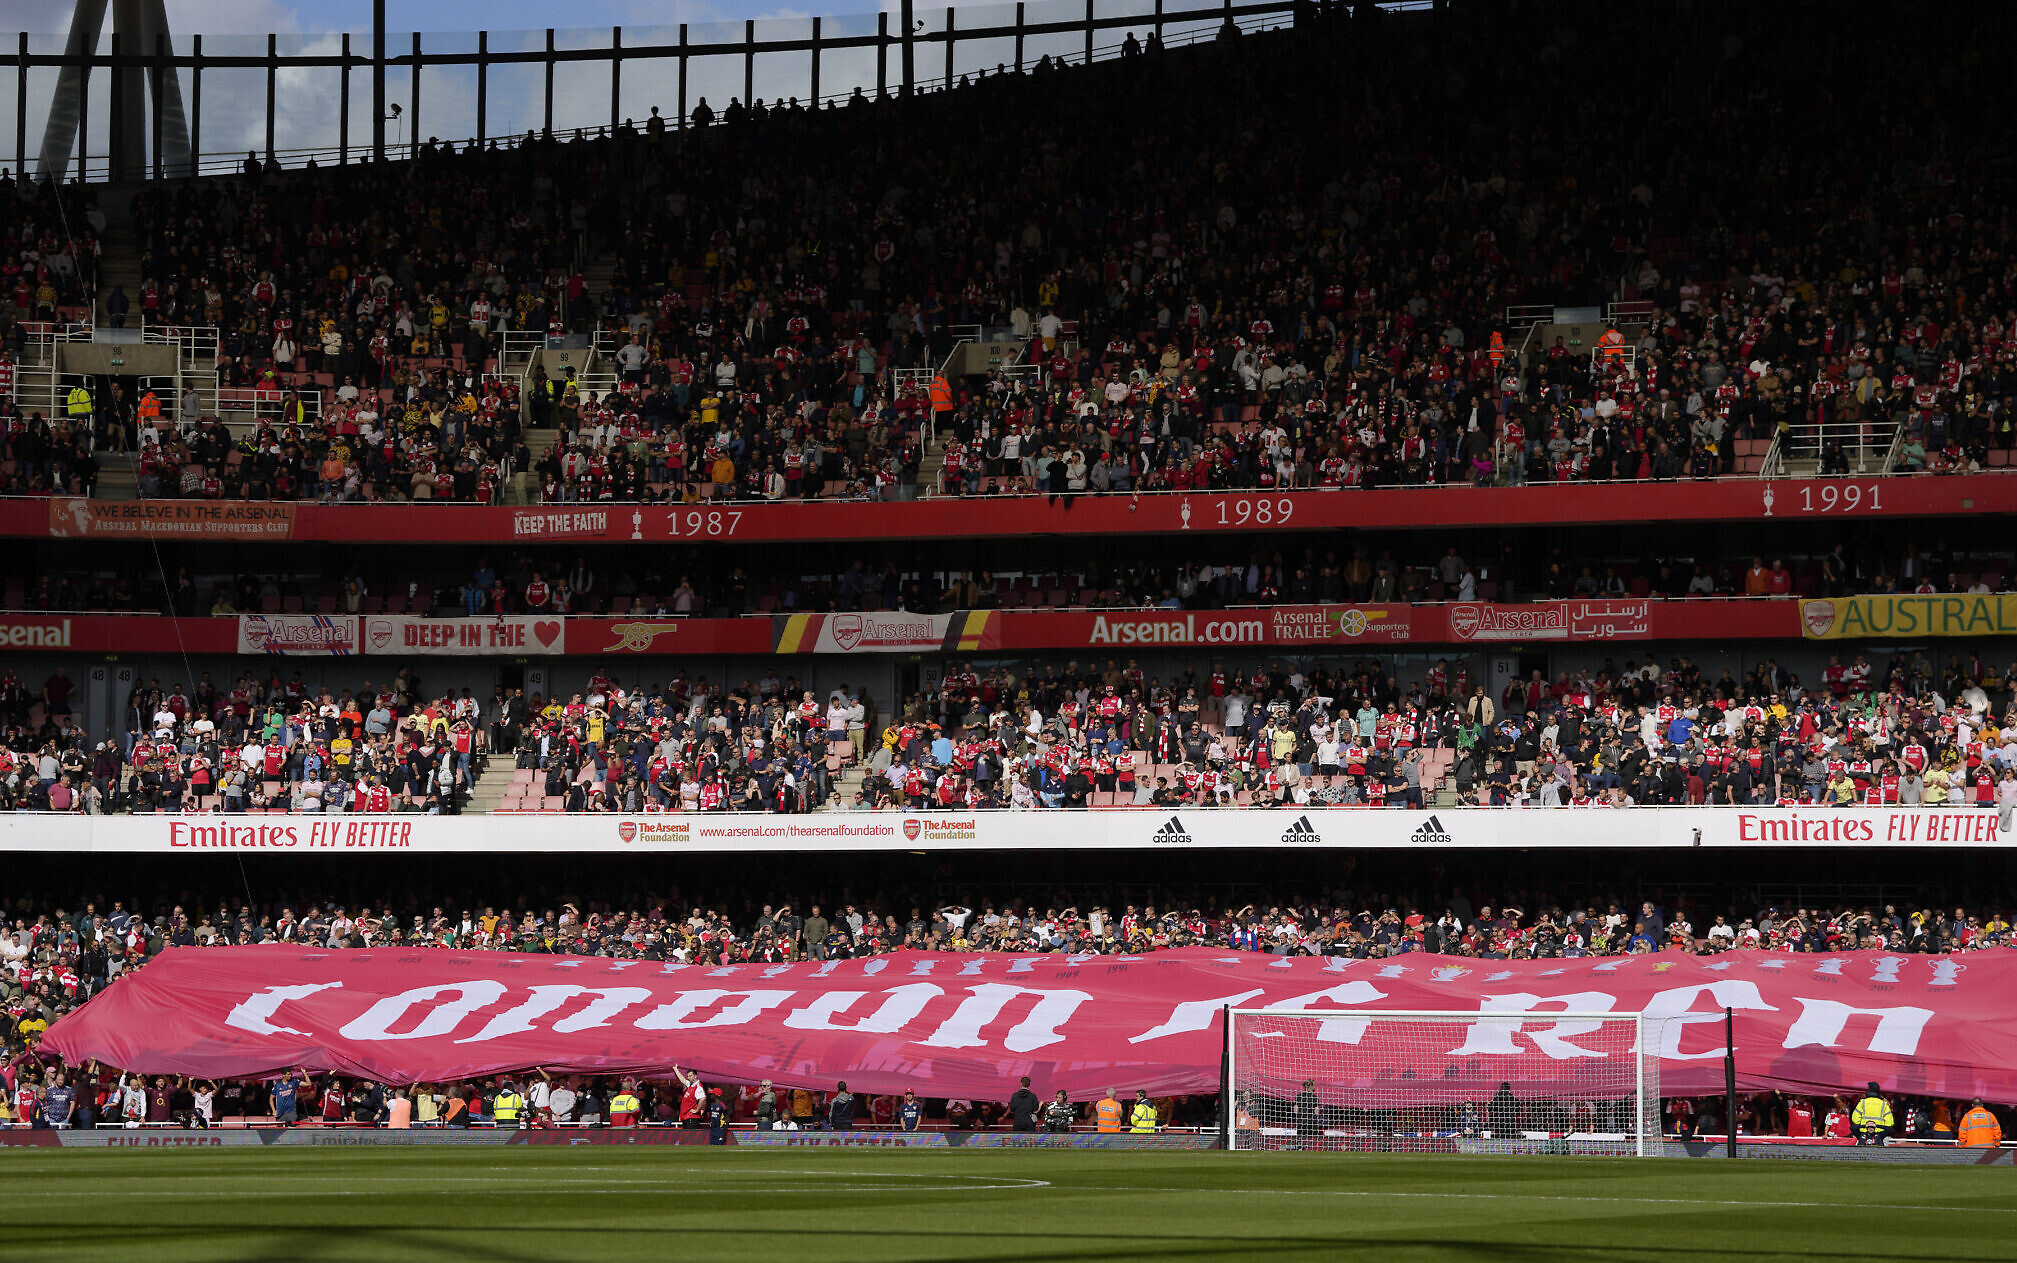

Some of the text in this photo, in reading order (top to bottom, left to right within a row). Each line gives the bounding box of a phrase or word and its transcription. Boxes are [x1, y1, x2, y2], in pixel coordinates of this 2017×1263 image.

[560, 352, 569, 361] 99
[1799, 485, 1882, 512] 1991
[94, 505, 288, 520] WE BELIEVE IN THE ARSENAL
[1216, 499, 1293, 525] 1989
[514, 512, 606, 535] KEEP THE FAITH
[666, 511, 742, 536] 1987
[1273, 608, 1327, 624] Arsenal
[1479, 604, 1568, 629] Arsenal
[1841, 597, 2017, 633] AUSTRAL
[0, 619, 71, 647] senal
[271, 619, 354, 642] Arsenal
[863, 619, 934, 639] Arsenal
[1089, 615, 1263, 643] Arsenal.com
[1273, 624, 1332, 639] TRALEE
[1367, 623, 1409, 632] Supporters
[404, 624, 525, 647] DEEP IN THE
[1391, 631, 1409, 639] Club
[1498, 662, 1509, 673] 51
[92, 670, 104, 681] 48
[119, 670, 131, 681] 48
[530, 672, 541, 684] 49
[639, 823, 690, 833] The Arsenal
[700, 824, 894, 838] www.arsenal.com/thearsenalfoundation
[923, 820, 975, 830] The Arsenal
[1738, 813, 1999, 841] Emirates FLY BETTER
[169, 821, 412, 847] Emirates FLY BETTER
[640, 832, 690, 842] Foundation
[924, 830, 975, 840] Foundation
[1153, 833, 1192, 843] adidas
[1281, 832, 1321, 843] adidas
[1411, 832, 1452, 843] adidas
[1812, 975, 1838, 984] 2015
[1869, 984, 1895, 992] 2017
